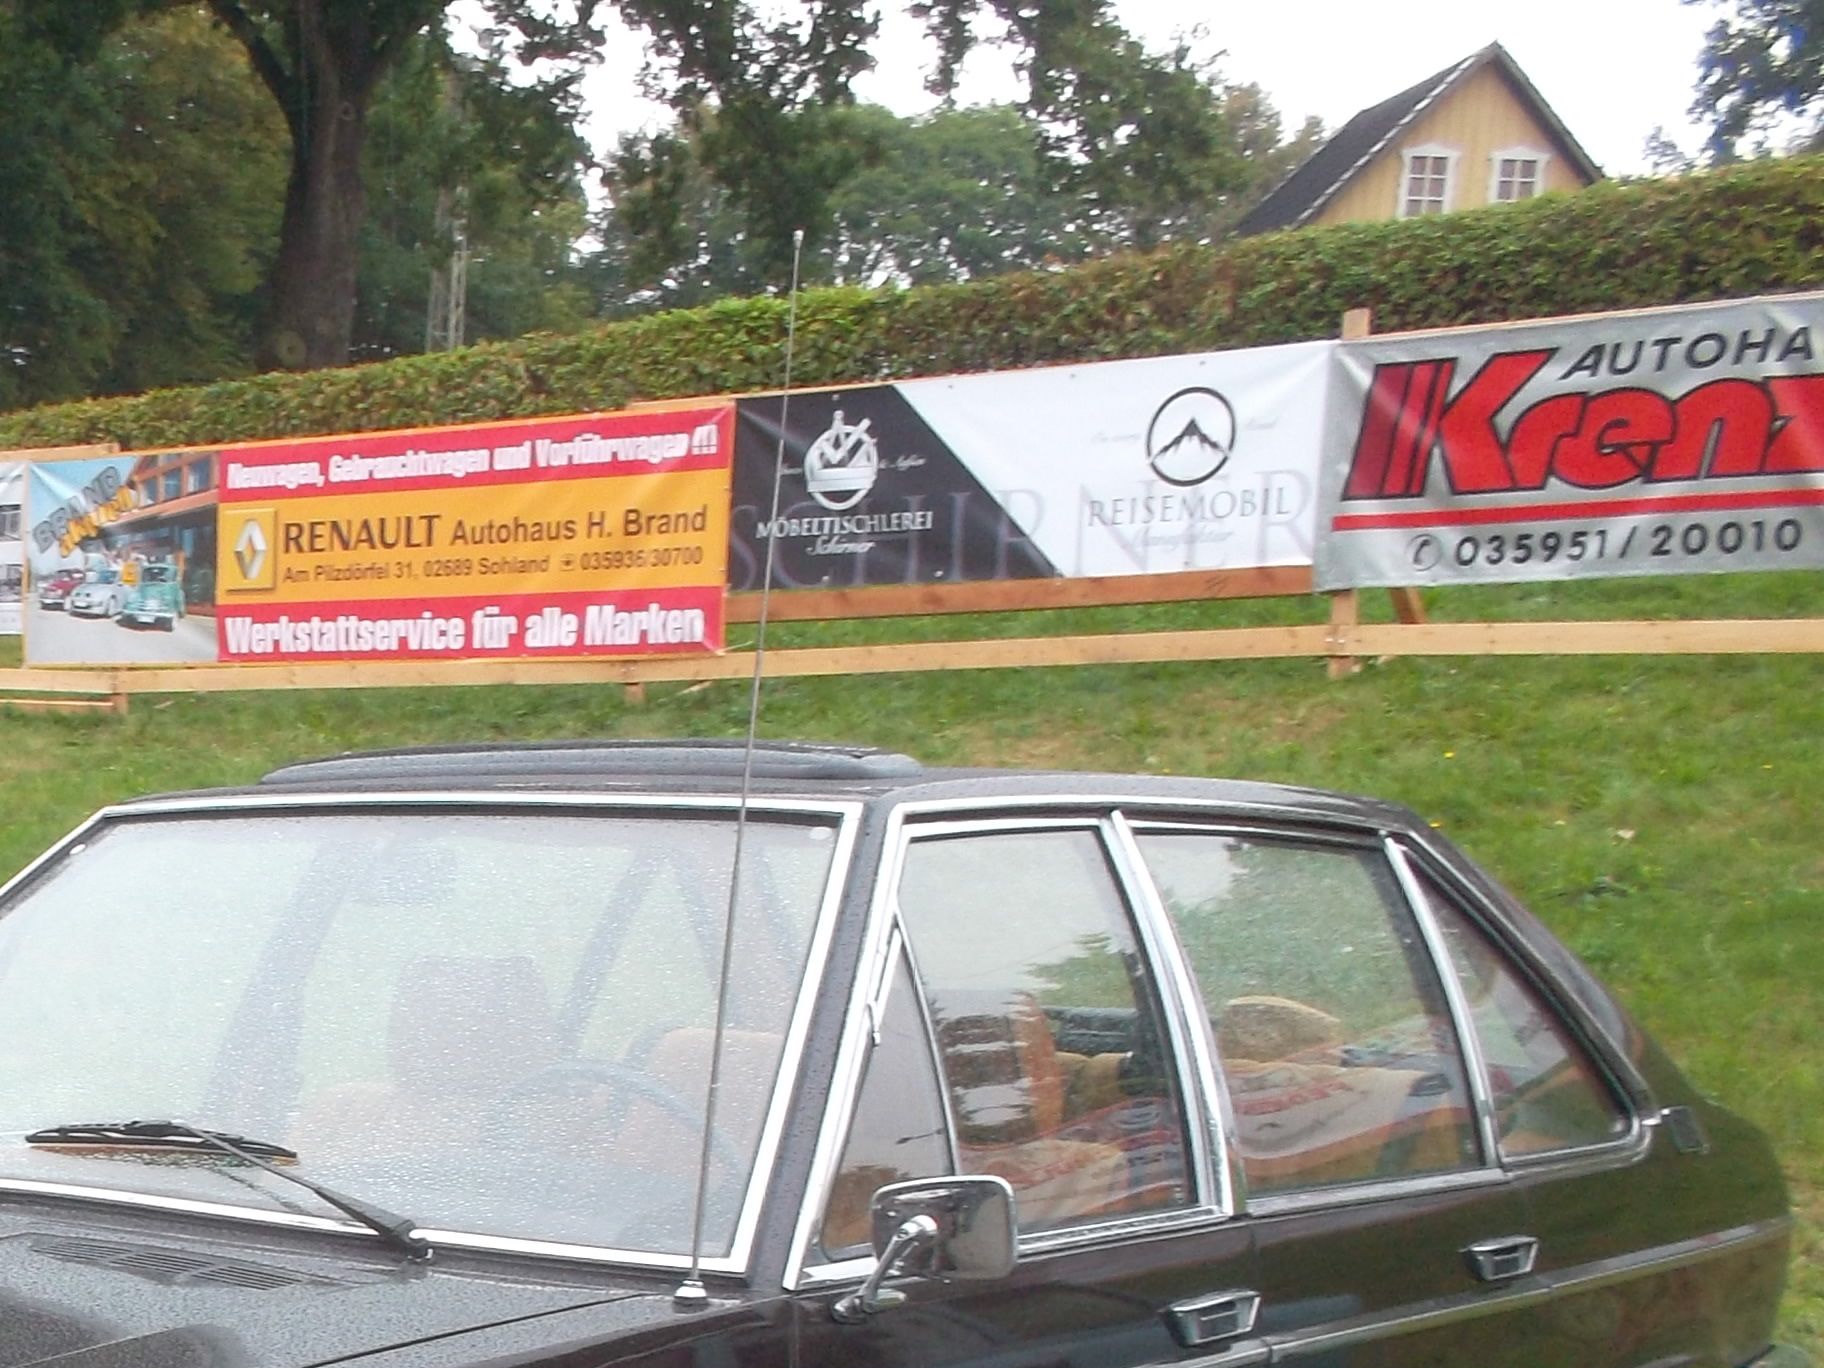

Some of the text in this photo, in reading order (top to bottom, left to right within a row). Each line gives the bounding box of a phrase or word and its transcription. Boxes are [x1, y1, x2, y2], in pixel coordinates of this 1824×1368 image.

[227, 462, 325, 488] Neuwagen,
[329, 449, 490, 482] Gebrauchtwagen
[493, 440, 531, 470] und
[535, 433, 688, 467] Vorführwagen
[755, 511, 934, 539] MÖBELTISCHLEREI
[1087, 486, 1292, 527] REISEMOBIL
[283, 505, 708, 554] RENAULT Autohaus H. Brand
[283, 567, 309, 582] Am
[478, 556, 551, 575] Sohland
[224, 602, 705, 654] Werkstattservice für alle Marken
